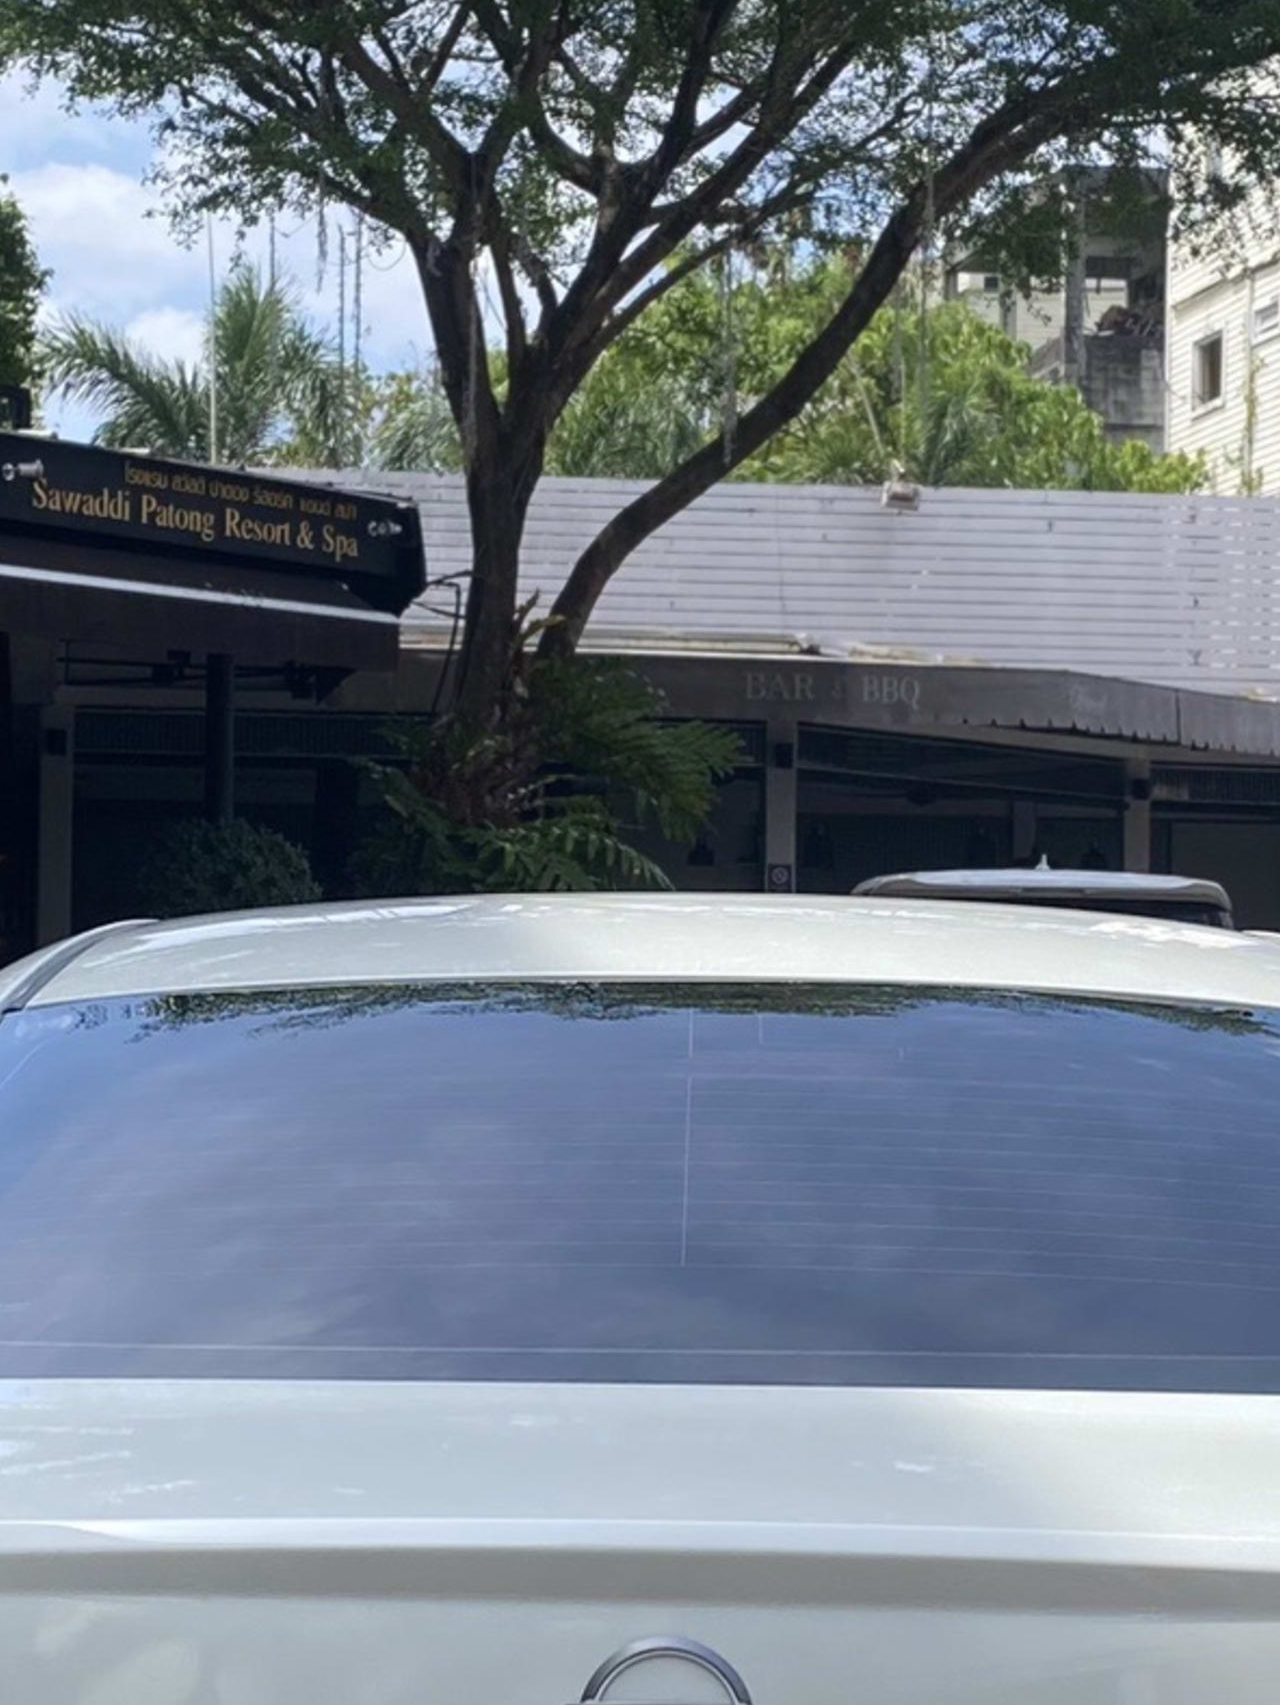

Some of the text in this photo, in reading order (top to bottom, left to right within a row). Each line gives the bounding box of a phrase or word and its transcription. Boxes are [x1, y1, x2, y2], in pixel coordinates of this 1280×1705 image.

[32, 477, 359, 563] Sawaddi Patong Resort & Spa
[745, 672, 815, 701] BAR
[863, 676, 920, 711] BBQ
